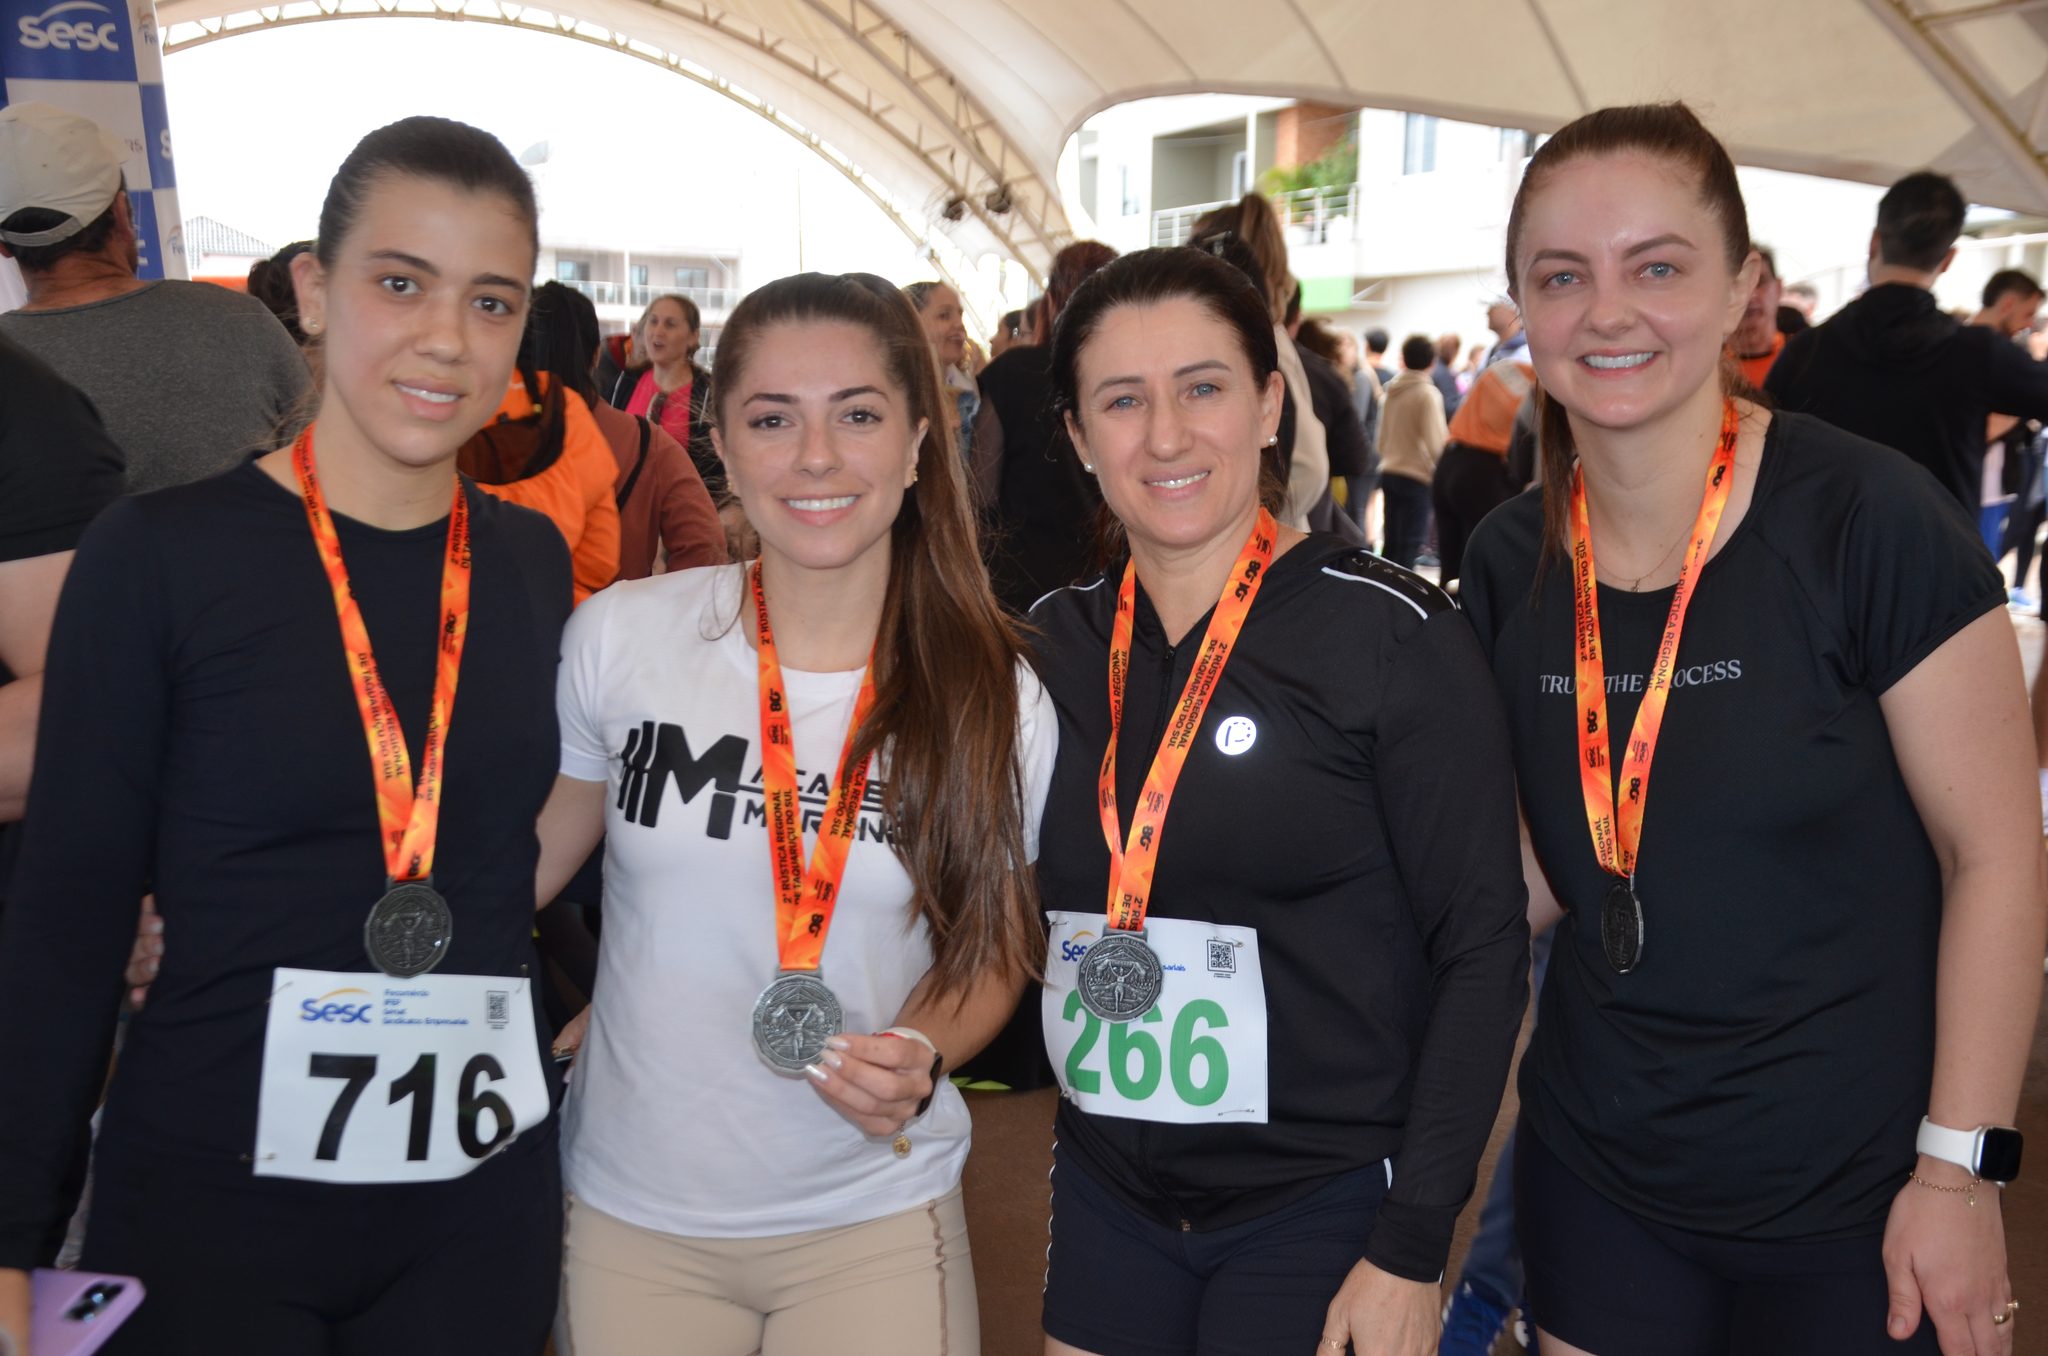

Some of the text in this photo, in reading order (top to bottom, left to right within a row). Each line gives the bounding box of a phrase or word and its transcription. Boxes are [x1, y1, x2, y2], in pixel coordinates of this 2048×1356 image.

[18, 14, 120, 51] Sesc
[1578, 538, 1597, 660] DE TAQUARUÇU DO SUL
[1576, 598, 1586, 650] RÚSTICA
[1111, 649, 1122, 698] REGIONAL
[1200, 655, 1223, 698] RÚSTICA
[1604, 674, 1643, 693] THE
[1670, 659, 1742, 689] OCESS
[1655, 632, 1675, 691] REGIONAL
[1167, 639, 1218, 749] DE TAQUARUÇU DO SUL
[1176, 699, 1201, 750] REGIONAL
[774, 791, 785, 843] REGIONAL
[784, 789, 792, 807] SUL
[786, 809, 795, 823] DO
[841, 787, 861, 838] REGIONAL
[830, 817, 841, 835] SUL
[1603, 814, 1612, 836] SUL
[778, 847, 791, 891] RÚSTICA
[788, 824, 801, 888] TAQUARUÇU
[1122, 893, 1132, 907] DE
[301, 999, 372, 1023] Sesc
[1062, 989, 1229, 1107] 266
[309, 1053, 515, 1161] 716
